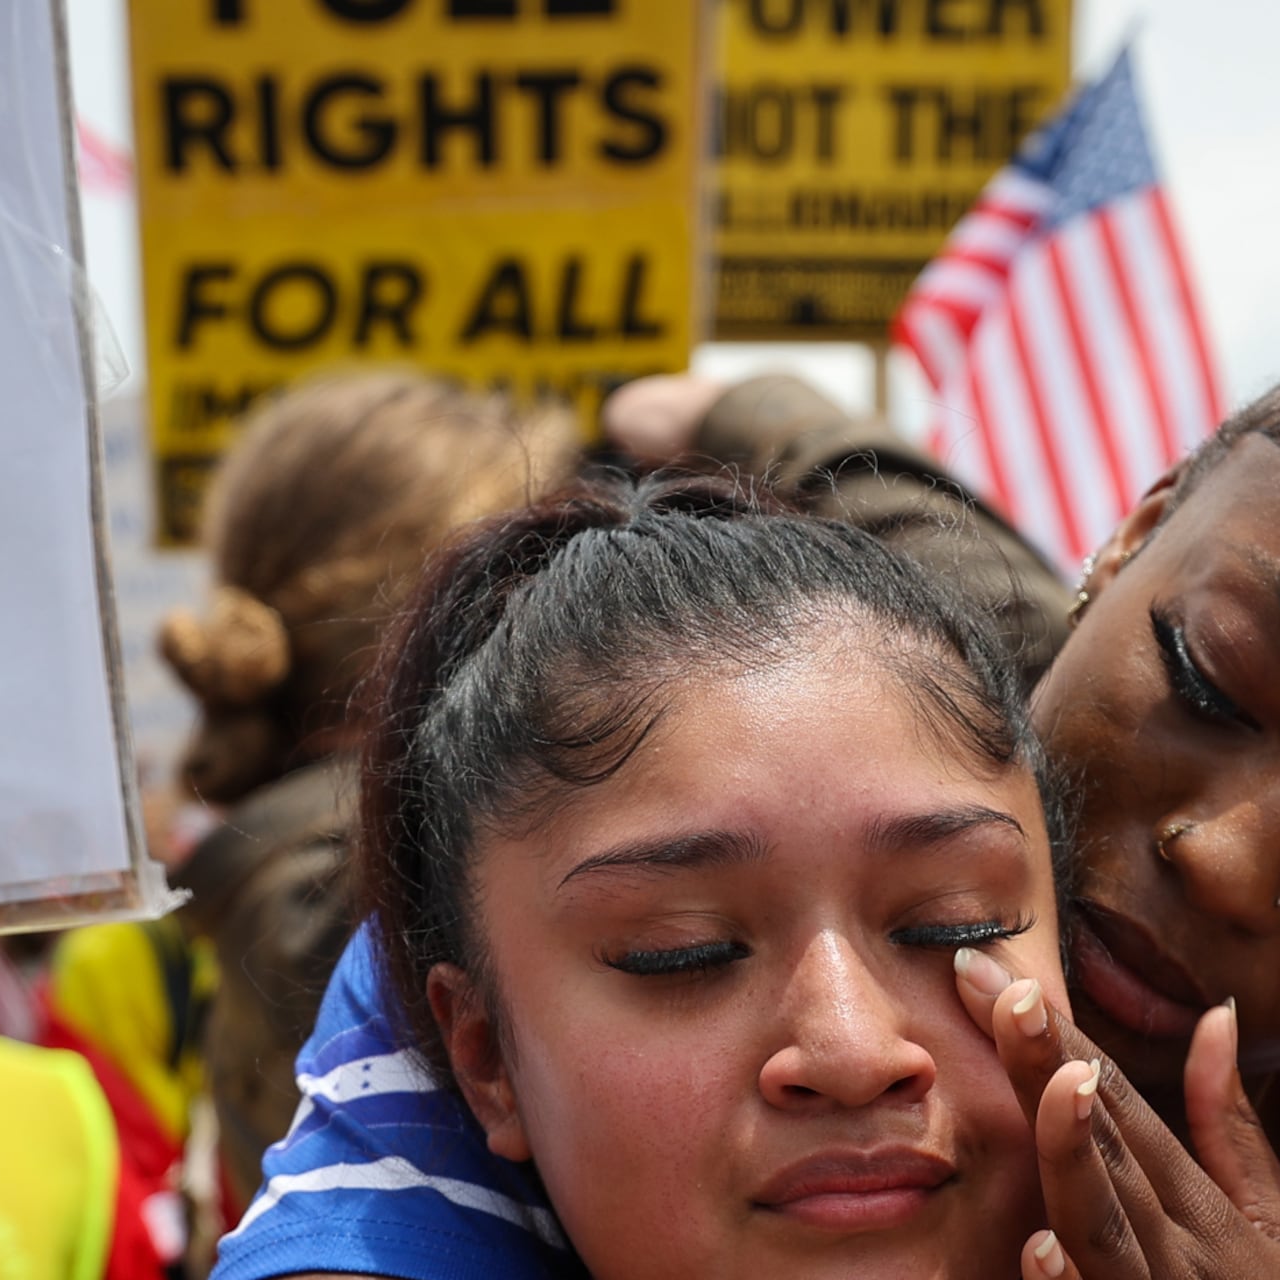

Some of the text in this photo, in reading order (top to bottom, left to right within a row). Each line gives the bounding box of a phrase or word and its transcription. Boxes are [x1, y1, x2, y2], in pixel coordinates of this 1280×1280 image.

[160, 64, 672, 178] RIGHTS
[173, 254, 426, 353] FOR
[456, 246, 668, 348] ALL
